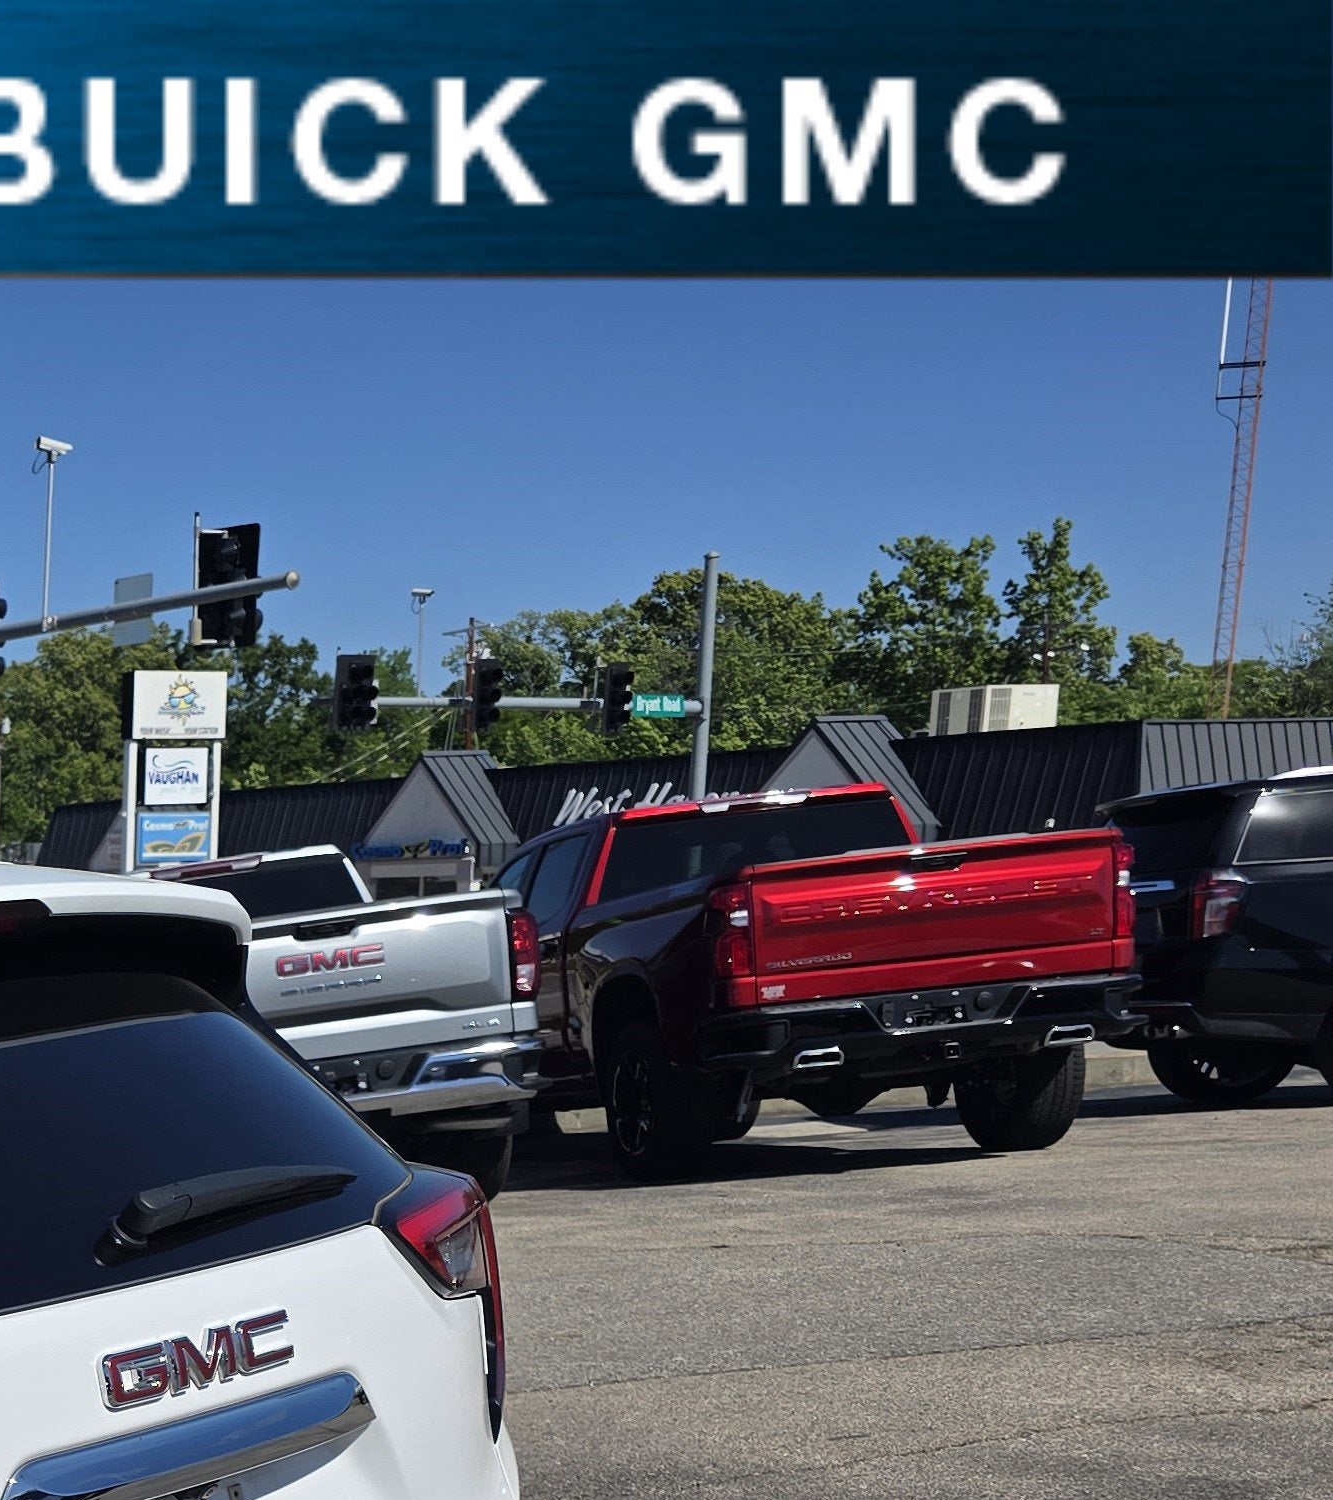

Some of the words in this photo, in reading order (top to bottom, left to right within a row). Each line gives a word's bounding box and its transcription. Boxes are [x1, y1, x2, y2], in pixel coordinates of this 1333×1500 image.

[636, 695, 661, 715] Bryant
[663, 695, 681, 712] Road
[148, 771, 199, 785] VAUGHAN
[553, 786, 632, 826] West
[276, 943, 385, 978] GMC
[98, 1308, 295, 1412] GMC
